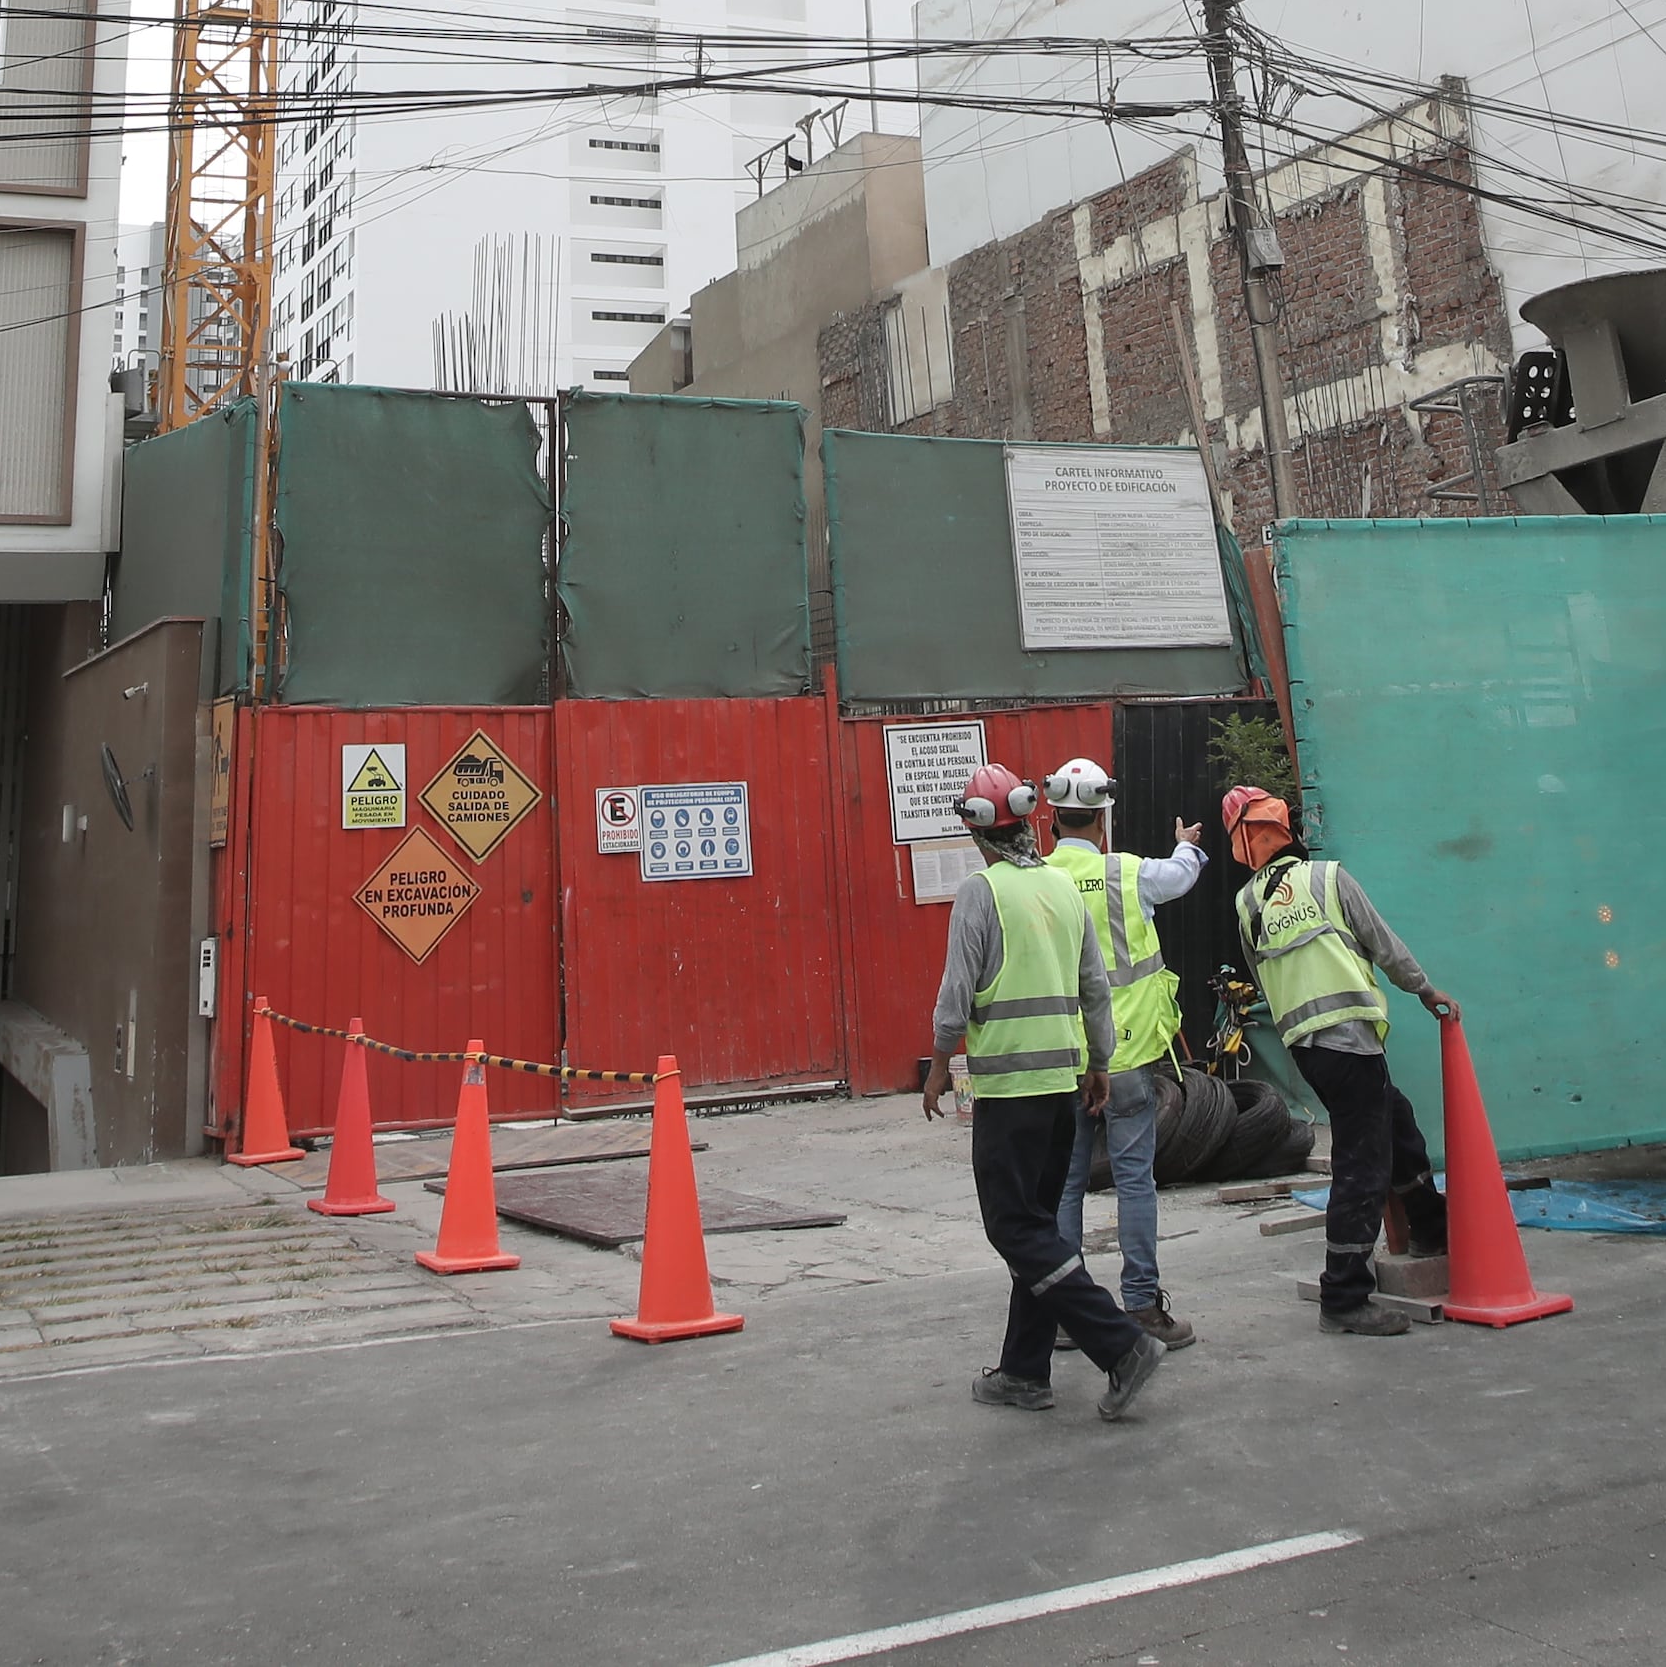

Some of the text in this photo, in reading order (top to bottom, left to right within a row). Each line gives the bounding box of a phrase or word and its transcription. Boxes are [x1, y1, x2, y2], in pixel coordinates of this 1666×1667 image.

[1055, 467, 1163, 480] CARTEL INFORMATIVO
[1045, 480, 1177, 493] PROYECTO DE EDIFICACIÓN
[908, 733, 941, 743] ENCUENTRA
[941, 731, 972, 741] PROHIBIDO
[911, 744, 959, 756] EL ACOSO SEXUAL
[895, 756, 978, 769] EN CONTRA DE LAS PERSONAS,
[905, 769, 970, 781] EN ESPECIAL MUJERES,
[897, 784, 916, 795] NIÑAS,
[916, 782, 933, 793] NIÑOS
[934, 783, 939, 792] Y
[351, 795, 398, 806] PELIGRO
[452, 790, 505, 800] CUIDADO
[448, 801, 509, 812] SALIDA DE
[909, 797, 922, 807] QUE
[922, 797, 929, 805] SE
[610, 797, 626, 821] E
[900, 808, 931, 820] TRANSITEN
[931, 807, 943, 818] POR
[447, 812, 510, 823] CAMIONES
[602, 829, 639, 841] PROHIBIDO
[602, 841, 639, 849] ESTACIONARSE
[390, 871, 446, 885] PELIGRO
[365, 883, 471, 903] EN EXCAVACIÓN
[383, 902, 454, 918] PROFUNDA
[1267, 905, 1316, 936] CYGNUS
